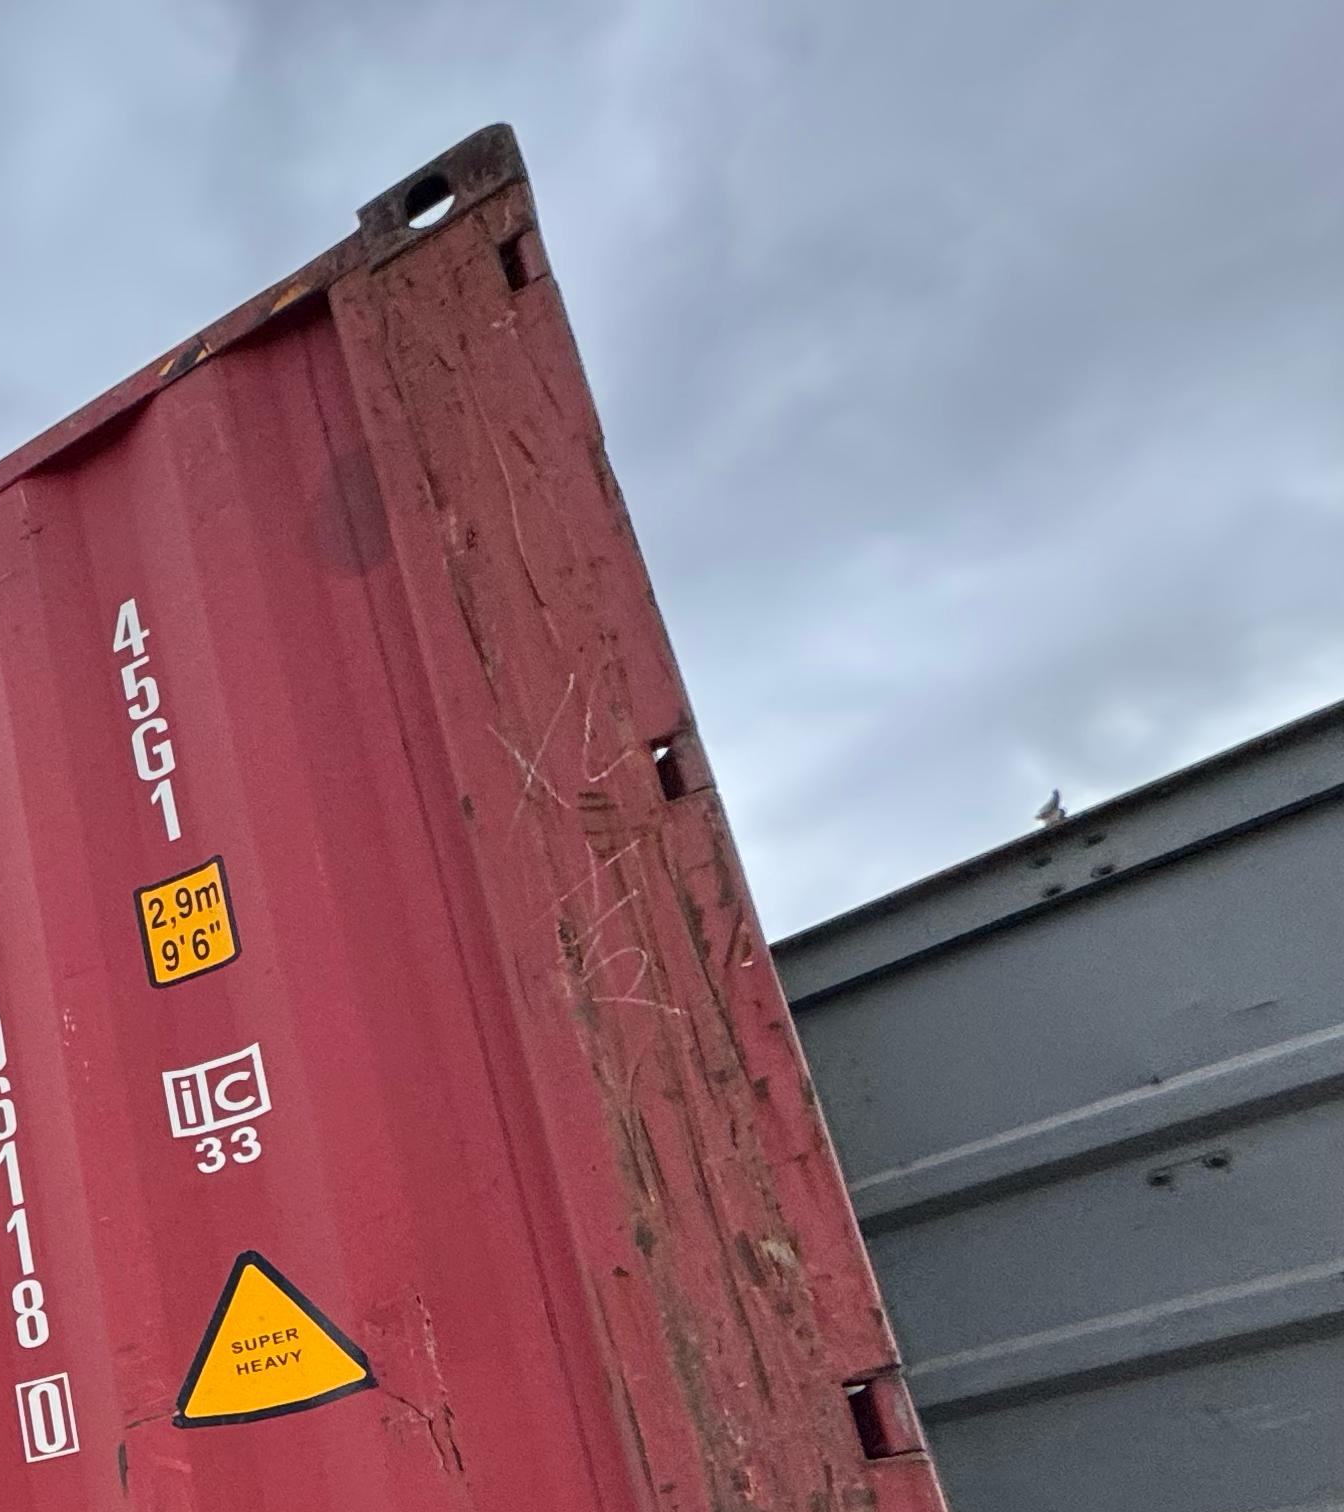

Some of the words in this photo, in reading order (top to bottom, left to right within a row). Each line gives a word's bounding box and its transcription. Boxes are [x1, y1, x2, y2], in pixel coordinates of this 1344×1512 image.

[113, 598, 182, 843] 45G1
[147, 880, 221, 933] 2,9m
[195, 1126, 263, 1174] 33
[231, 1327, 300, 1355] SUPER
[236, 1349, 304, 1377] HEAVY
